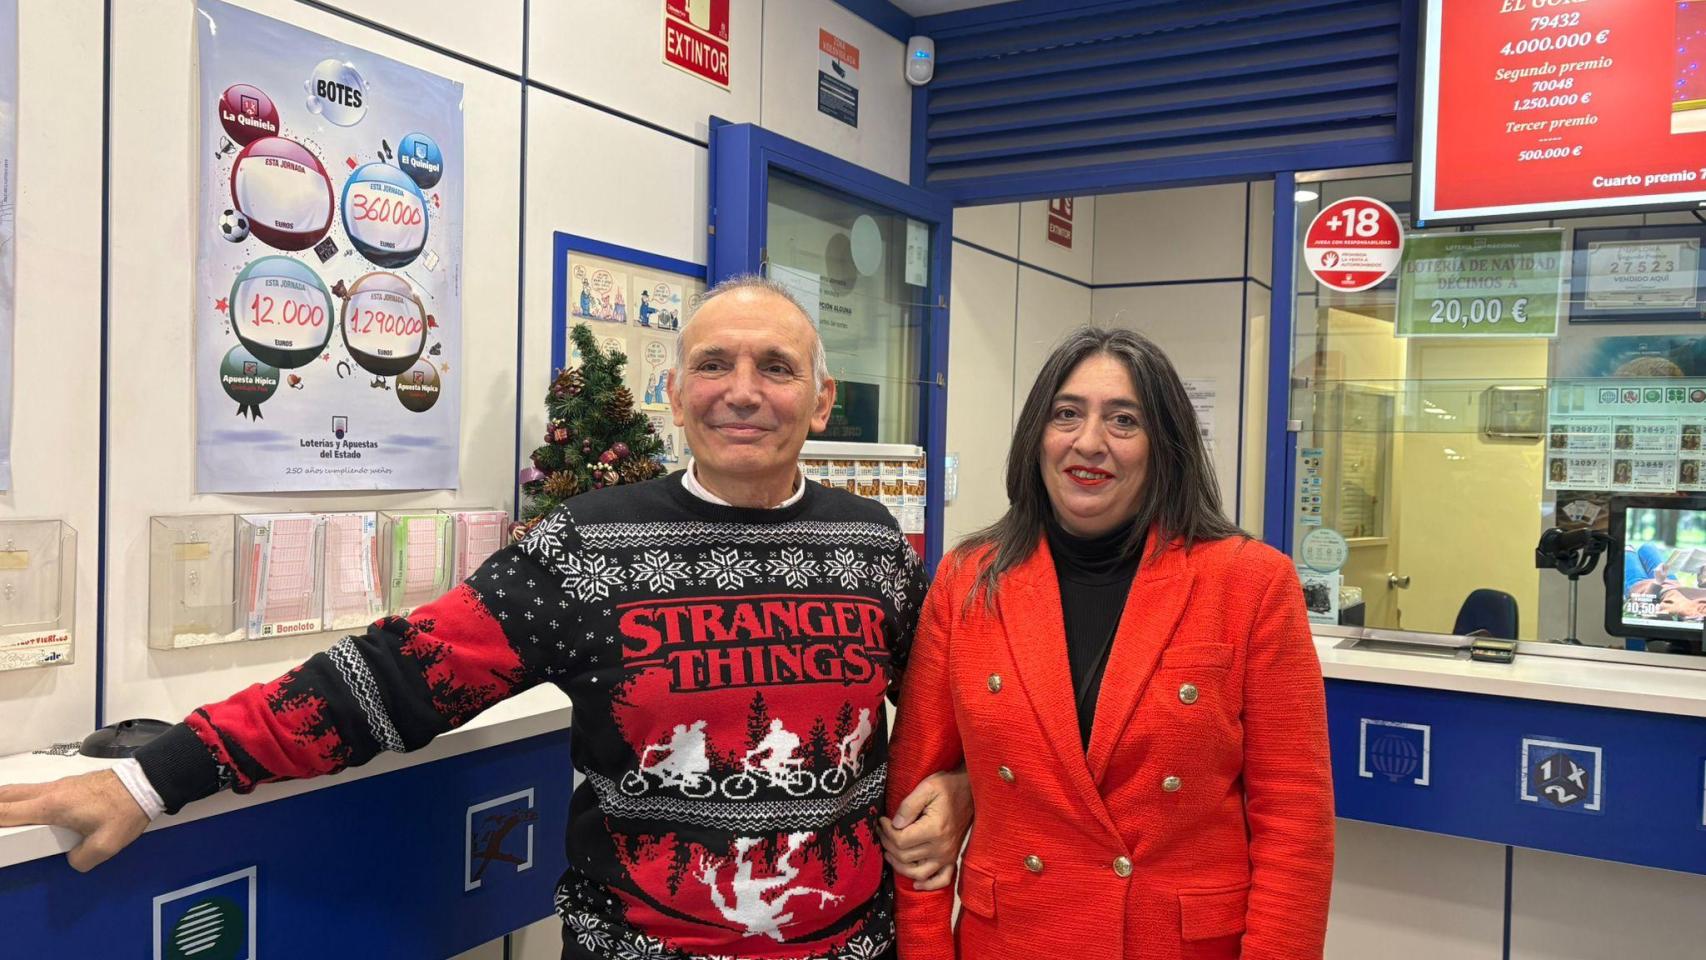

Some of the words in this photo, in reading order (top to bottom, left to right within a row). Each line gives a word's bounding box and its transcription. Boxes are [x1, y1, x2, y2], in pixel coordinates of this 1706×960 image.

[1530, 12, 1580, 31] 79432
[1500, 32, 1591, 56] 4.000.000
[1595, 29, 1610, 44] €
[667, 27, 728, 77] EXTINTOR
[1495, 62, 1557, 82] Segundo
[1559, 56, 1613, 77] premio
[1532, 78, 1573, 92] 70048
[317, 79, 362, 109] BOTES
[1513, 93, 1578, 111] 1.250.000
[1581, 92, 1592, 103] €
[223, 110, 235, 121] La
[238, 114, 275, 132] Quiniela
[1506, 120, 1548, 133] Tercer
[1549, 114, 1598, 132] premio
[1518, 146, 1570, 162] 500.000
[1572, 145, 1583, 157] €
[265, 158, 279, 168] ESTA
[280, 160, 306, 174] JORNADA
[402, 155, 409, 164] El
[411, 158, 439, 172] Quinigol
[1592, 174, 1642, 188] Cuarto
[1645, 169, 1697, 187] premio
[370, 183, 381, 191] ESTA
[382, 184, 404, 197] JORNADA
[275, 219, 294, 230] EUROS
[1326, 207, 1380, 238] +18
[379, 240, 395, 249] EUROS
[1469, 260, 1488, 272] DE
[1491, 256, 1555, 272] NAVIDAD
[1610, 261, 1674, 273] 27523
[265, 279, 279, 288] ESTA
[281, 279, 306, 291] JORNADA
[1507, 277, 1518, 289] A
[370, 293, 382, 301] ESTA
[383, 294, 405, 304] JORNADA
[251, 293, 325, 327] 12.000
[1429, 298, 1503, 329] 20,00
[1511, 298, 1528, 324] €
[274, 338, 293, 348] EUROS
[377, 348, 393, 356] EUROS
[223, 375, 253, 384] Apuesta
[398, 383, 421, 391] Apuesta
[300, 438, 334, 448] Loterías
[336, 441, 341, 450] y
[343, 439, 378, 451] Apuestas
[320, 450, 332, 458] del
[334, 450, 361, 459] Estado
[305, 466, 323, 474] años
[324, 466, 368, 477] cumpliendo
[276, 622, 315, 633] Bonoloto
[619, 601, 887, 658] STRANGER
[668, 643, 875, 689] THINGS
